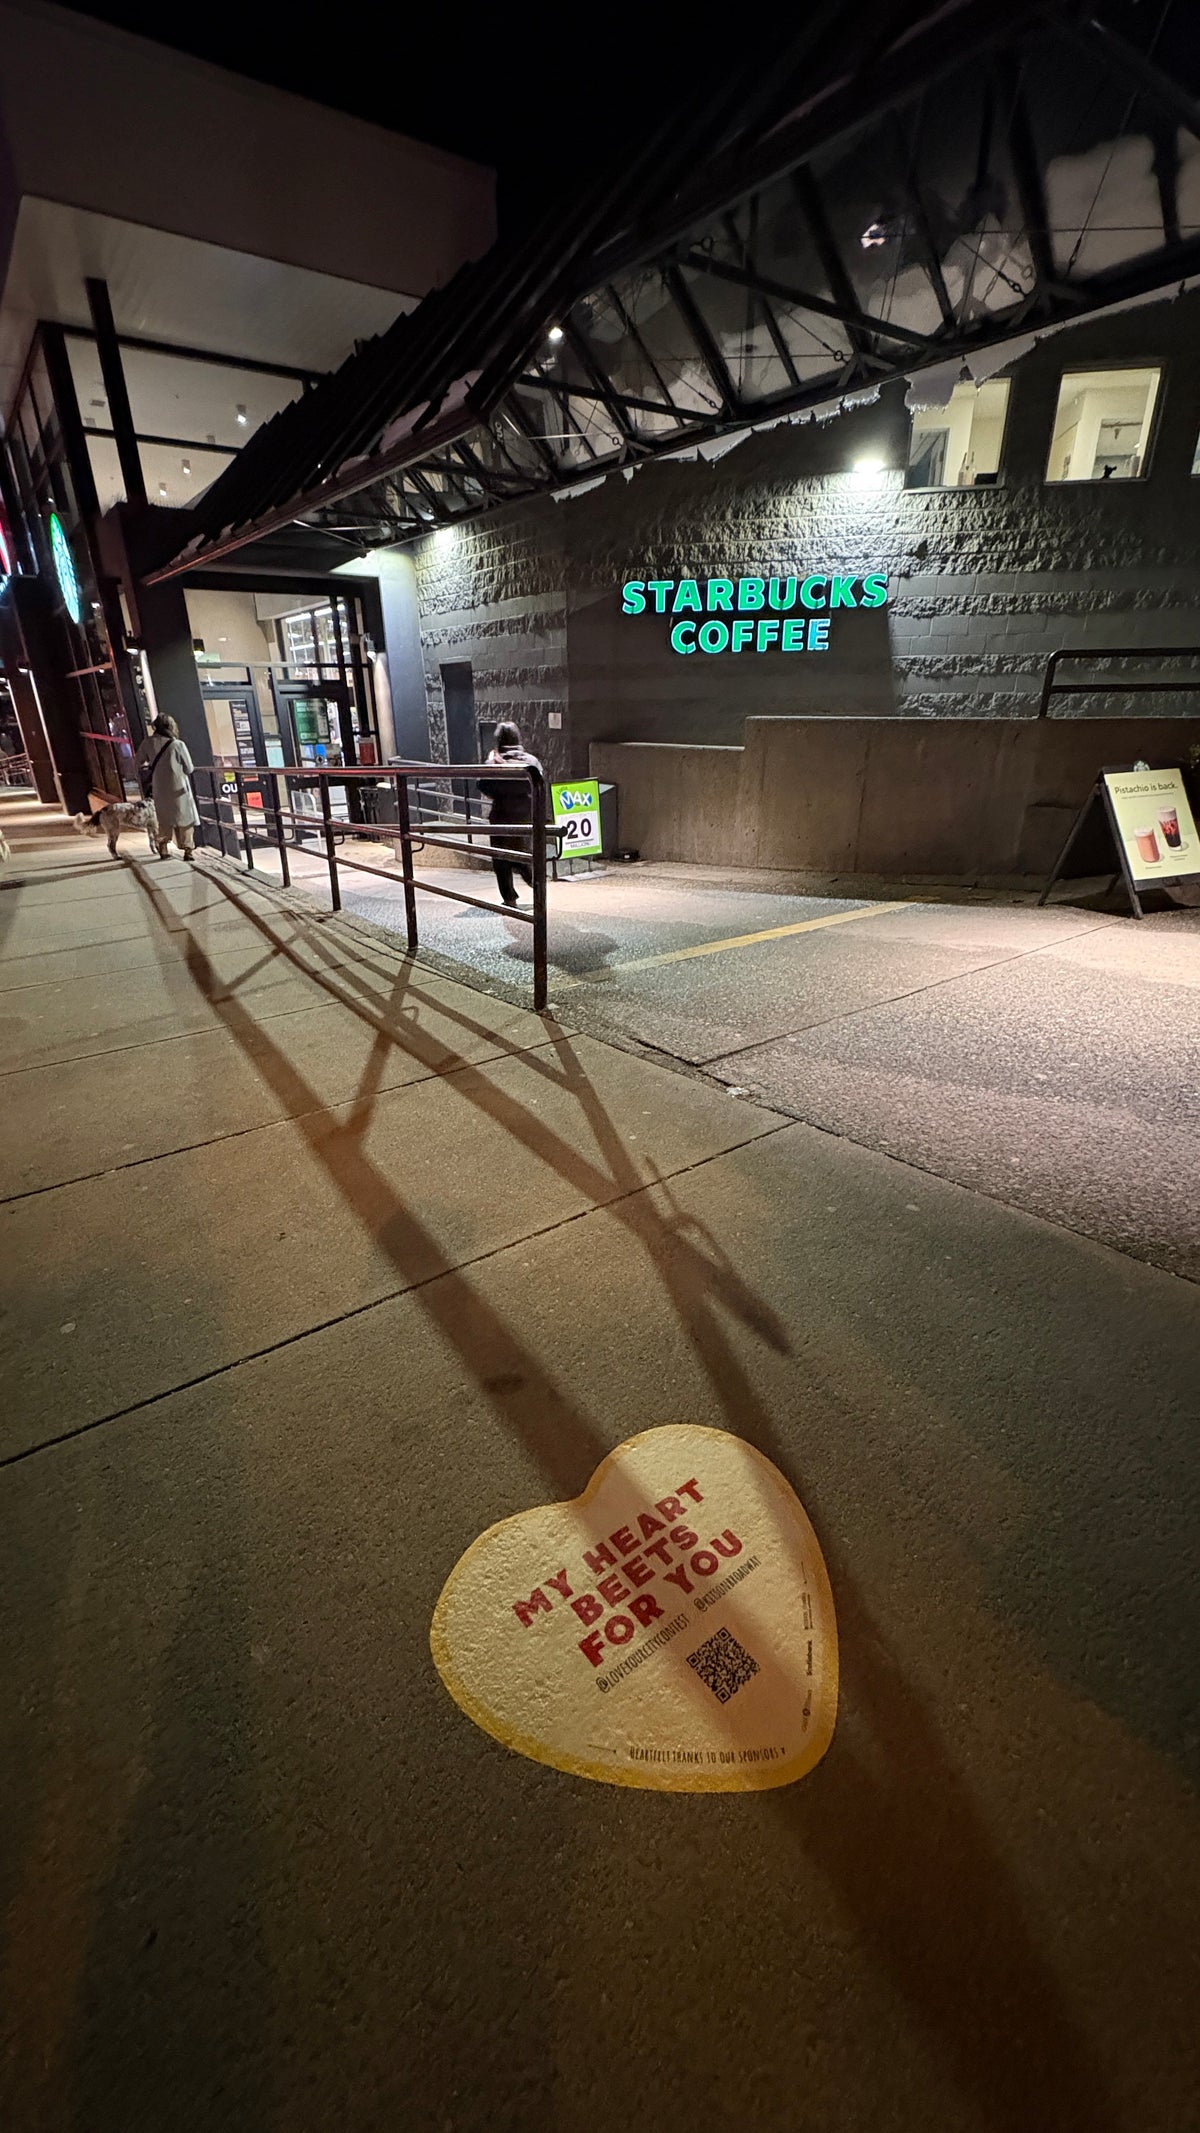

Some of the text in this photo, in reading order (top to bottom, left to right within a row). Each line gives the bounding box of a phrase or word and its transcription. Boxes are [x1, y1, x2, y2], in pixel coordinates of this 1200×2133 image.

[621, 573, 888, 614] STARBUCKS
[670, 618, 831, 655] COFFEE
[560, 791, 592, 810] MAX
[1114, 785, 1149, 794] Pistachio
[1150, 783, 1157, 791] is
[566, 818, 592, 839] 20
[512, 1478, 704, 1628] MY HEART
[570, 1525, 699, 1627] BEETS
[578, 1529, 743, 1668] FOR YOU
[596, 1613, 690, 1693] @LOVEYOURCITYCONTEST
[672, 1750, 703, 1764] THANKS
[706, 1751, 717, 1764] TO
[719, 1751, 735, 1764] OUR
[738, 1746, 779, 1763] SPONSORS
